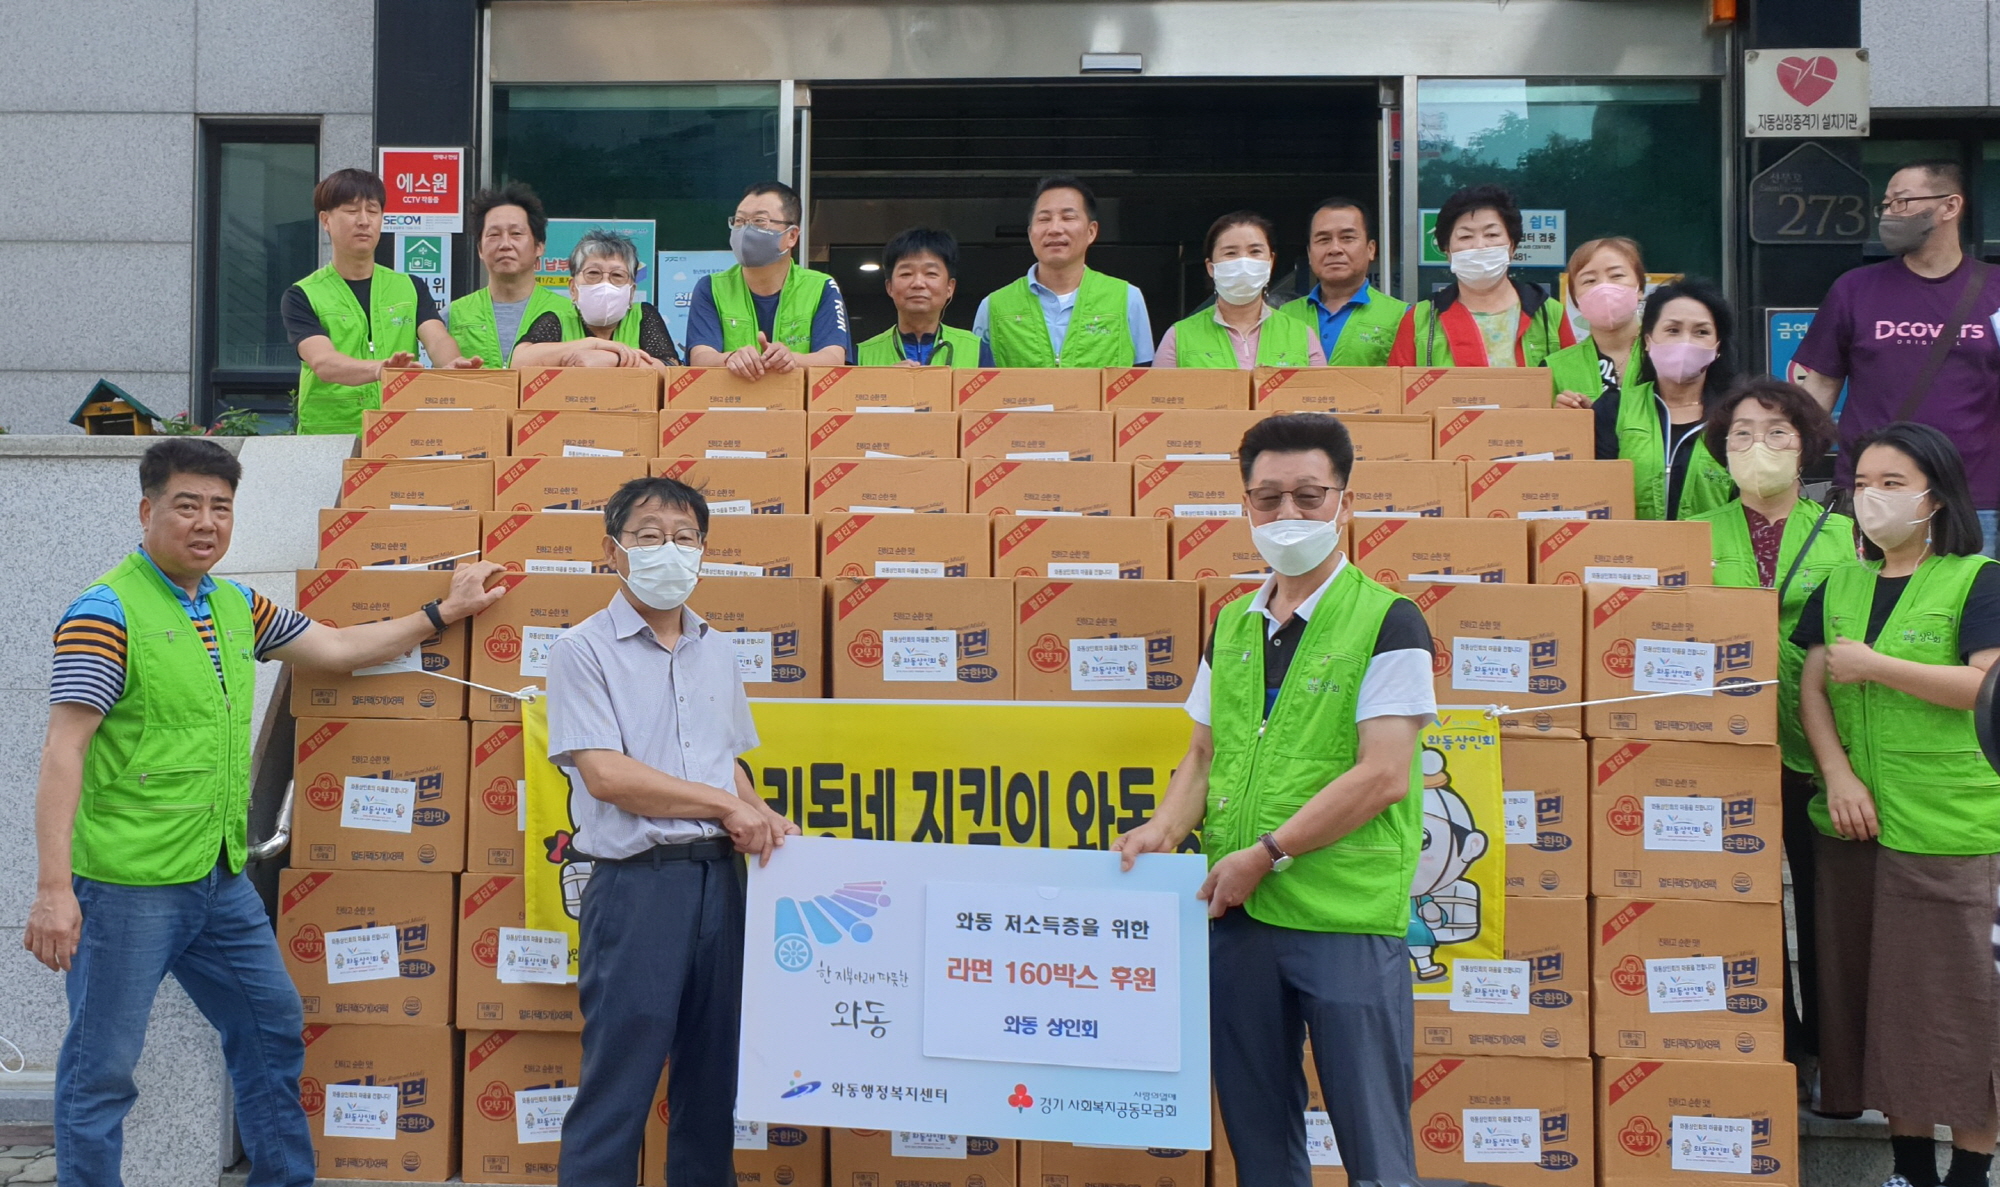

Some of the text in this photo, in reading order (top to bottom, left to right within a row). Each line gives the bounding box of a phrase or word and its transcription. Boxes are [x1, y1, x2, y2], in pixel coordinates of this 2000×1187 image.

[1758, 113, 1858, 131] 자동심장충격기 설치기관
[396, 173, 448, 194] 에스원
[402, 196, 421, 204] CCTV
[383, 215, 422, 225] SECOM
[1776, 194, 1866, 236] 273
[1530, 214, 1557, 230] 쉼터
[1538, 232, 1556, 243] 겸용
[1875, 320, 1984, 340] Dcovrs
[492, 642, 516, 652] 오뚜기
[855, 648, 880, 658] 오뚜기
[1036, 652, 1062, 663] 오뚜기
[958, 667, 993, 679] 순한맛
[1428, 735, 1495, 750] 와동상인회
[313, 791, 338, 802] 오뚜기
[490, 794, 514, 806] 오뚜기
[414, 811, 445, 822] 순한맛
[1614, 814, 1640, 826] 오뚜기
[1724, 838, 1760, 850] 순한맛
[956, 912, 992, 931] 와동
[1111, 920, 1150, 940] 위한
[298, 942, 322, 952] 오뚜기
[816, 960, 832, 984] 한
[947, 958, 1156, 992] 라면 160박스 후원
[1618, 974, 1645, 985] 오뚜기
[1532, 993, 1568, 1004] 순한맛
[1728, 998, 1762, 1010] 순한맛
[830, 1000, 892, 1039] 와동
[1003, 1016, 1098, 1039] 와동 상인회
[832, 1082, 948, 1104] 와동행정복지센터
[484, 1100, 510, 1111] 오뚜기
[1040, 1096, 1177, 1119] 경기 사회복지공동모금회
[396, 1116, 430, 1128] 순한맛
[768, 1129, 802, 1142] 순한맛
[1428, 1132, 1456, 1144] 오뚜기
[1626, 1135, 1654, 1146] 오뚜기
